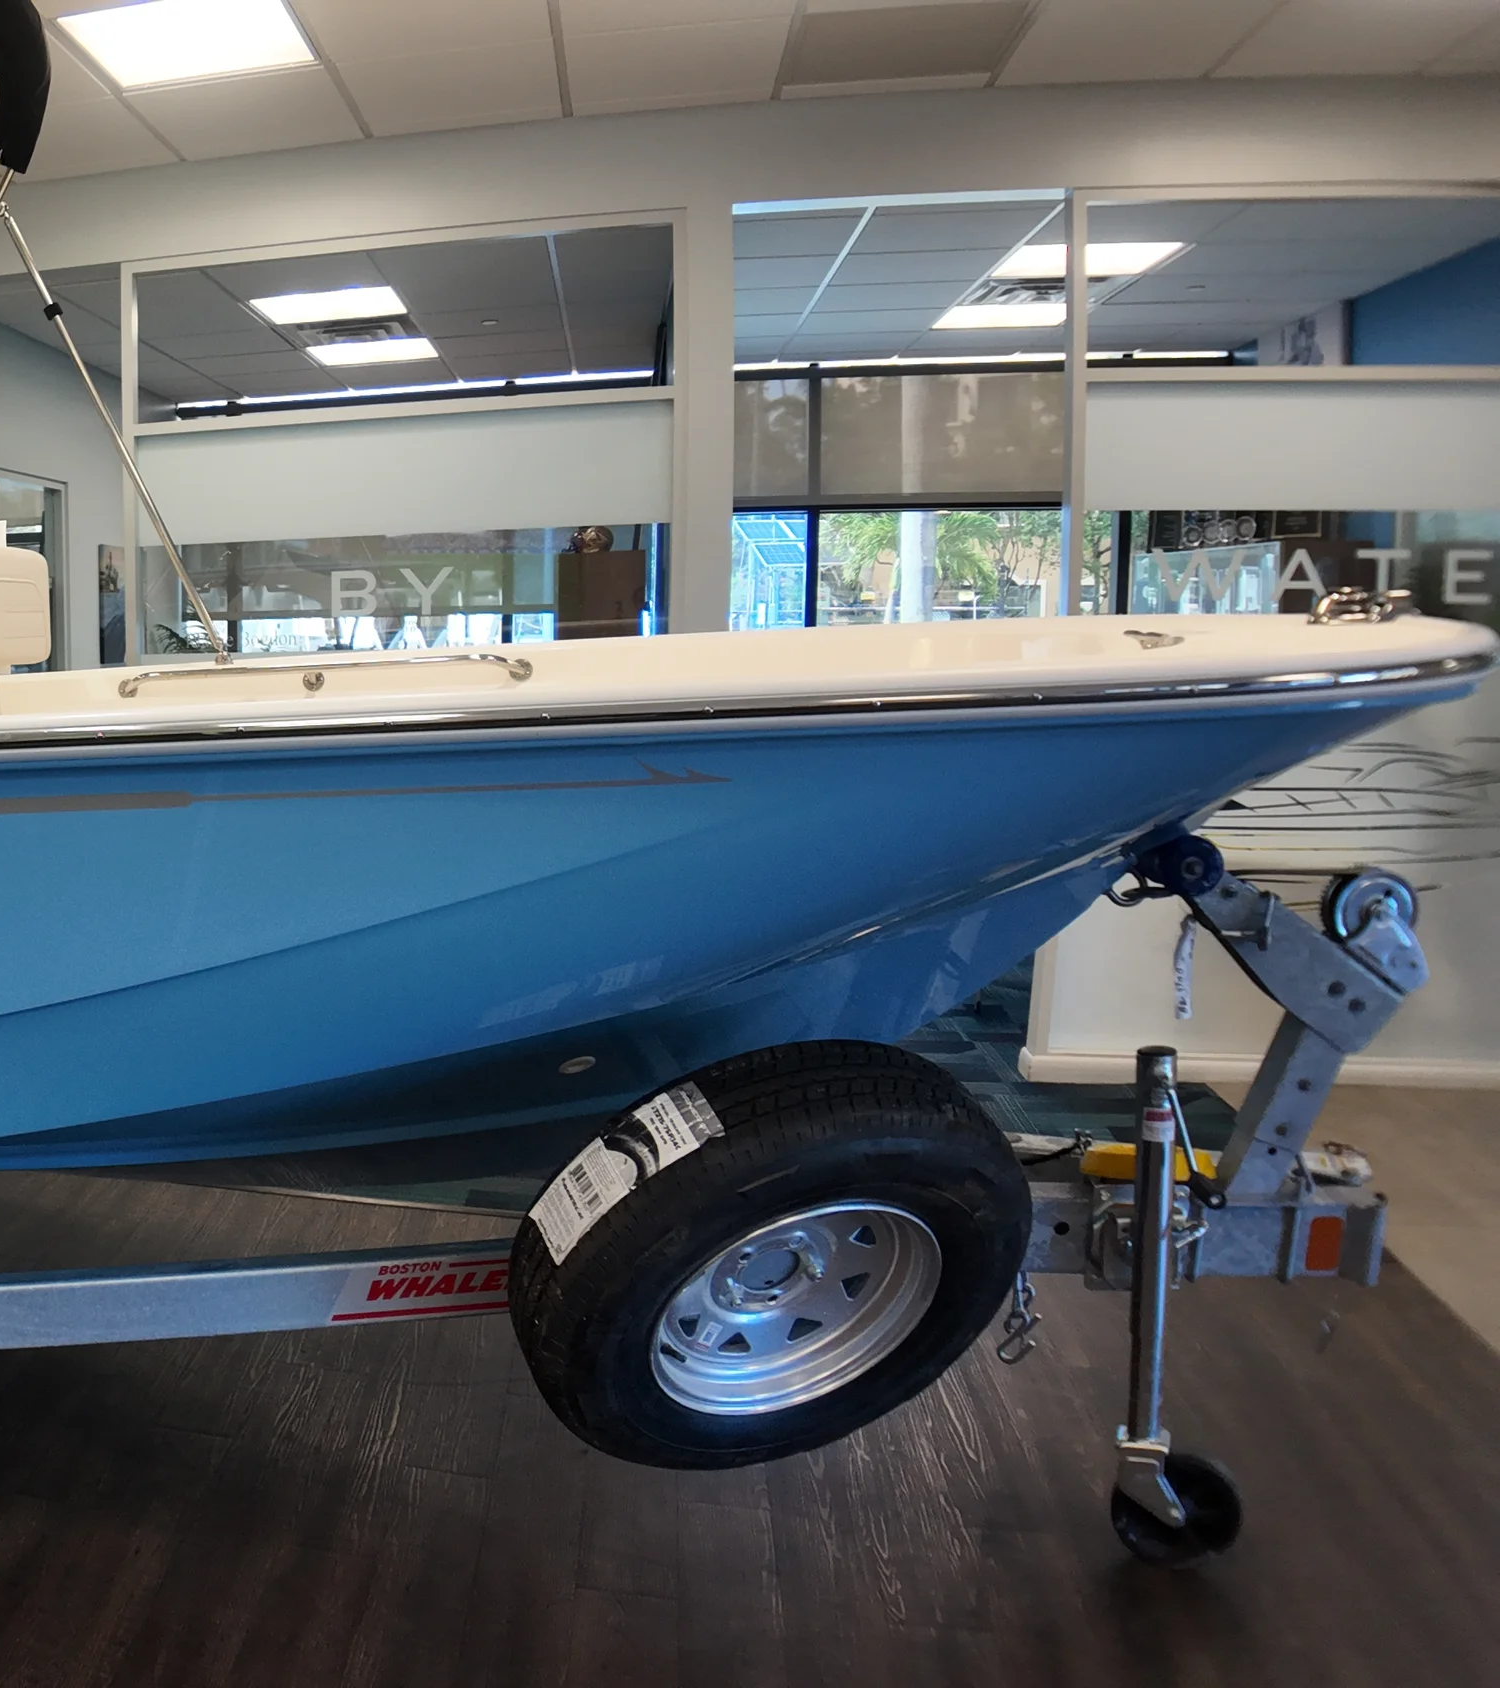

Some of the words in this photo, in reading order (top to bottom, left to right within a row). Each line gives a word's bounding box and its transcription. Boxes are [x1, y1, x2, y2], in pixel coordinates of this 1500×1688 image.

[331, 566, 455, 617] BY
[1152, 548, 1493, 606] WATE
[366, 1269, 509, 1301] WHALE
[378, 1261, 442, 1276] BOSTON
